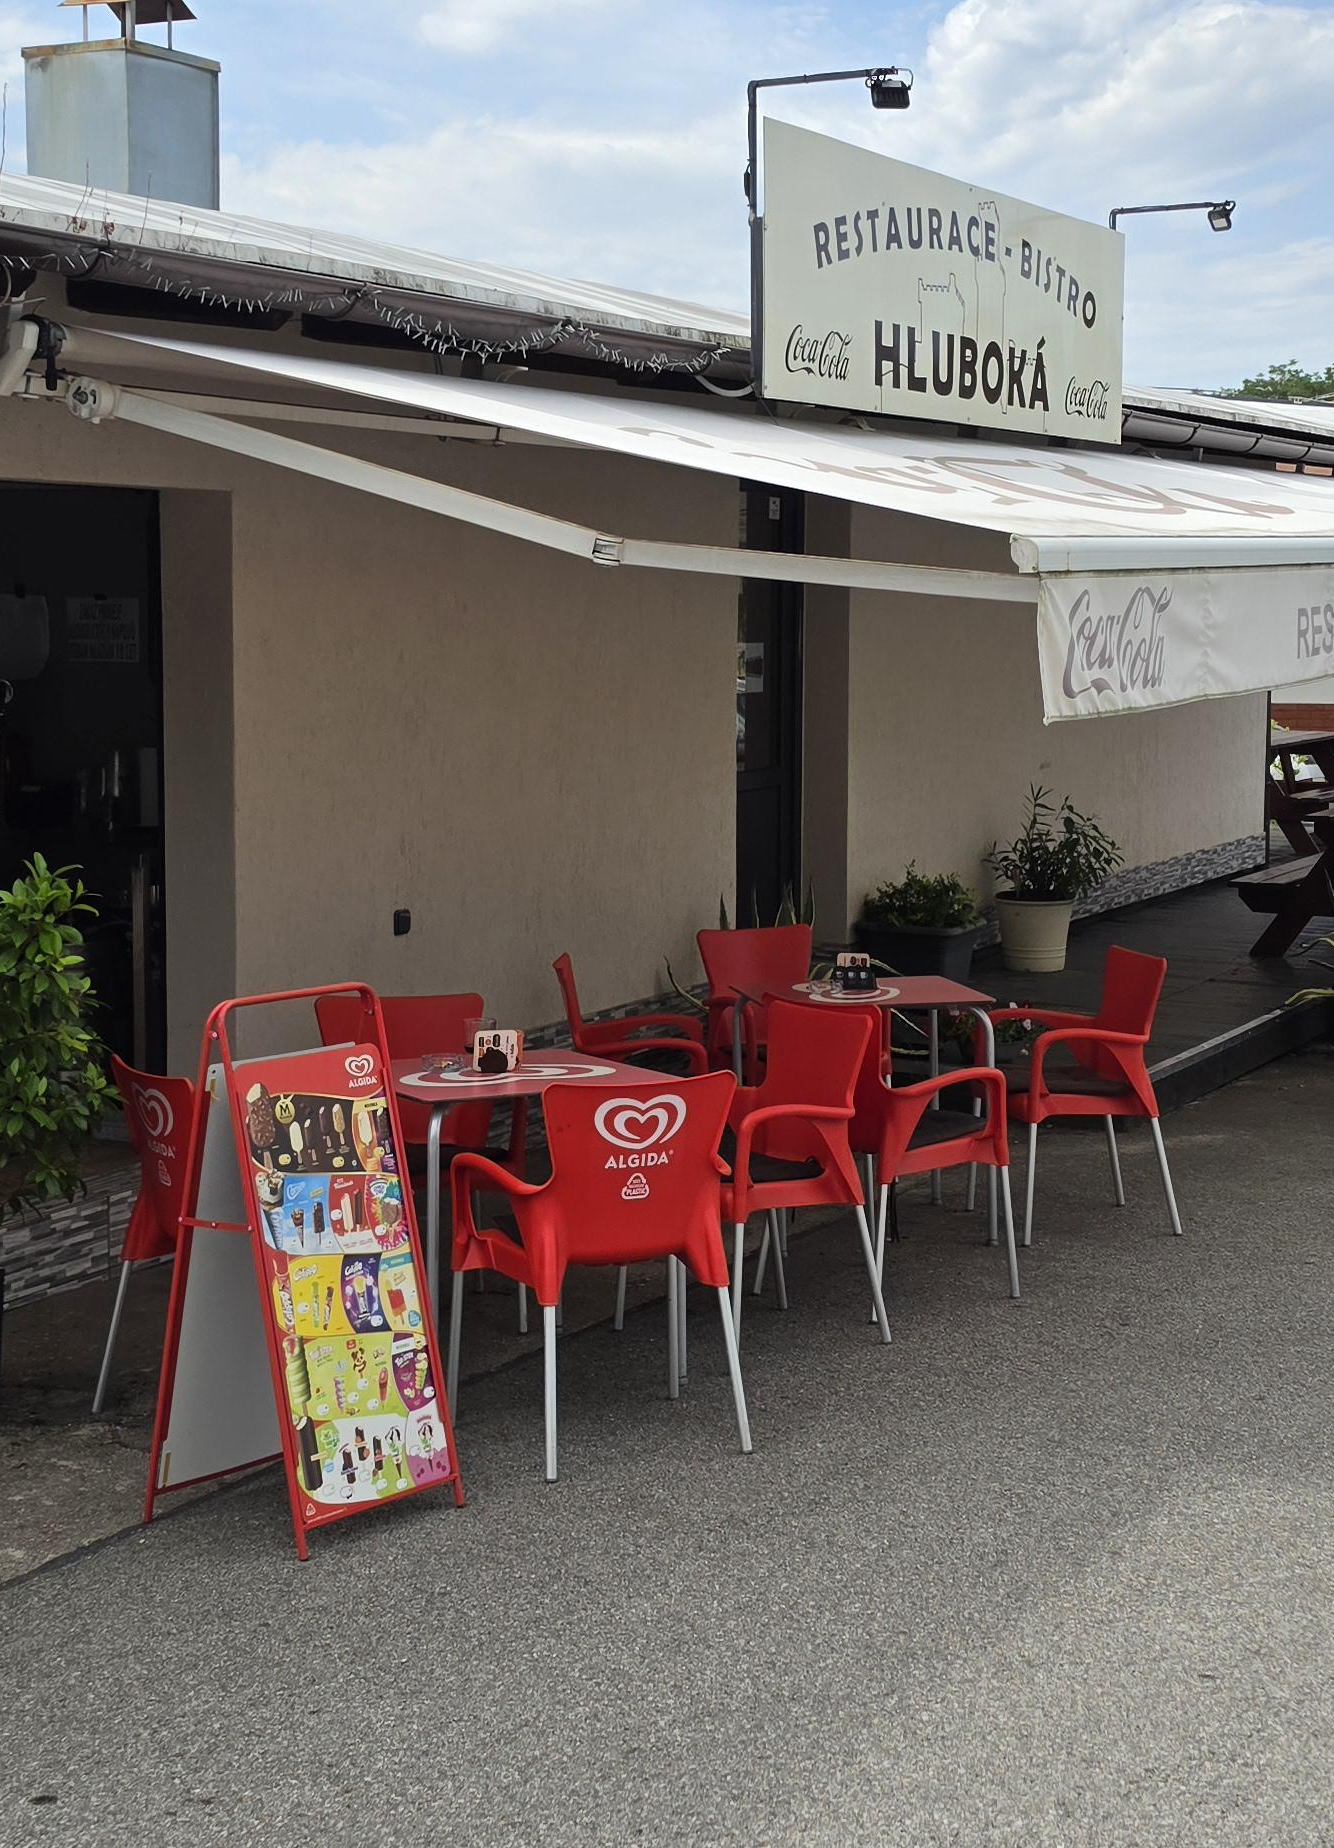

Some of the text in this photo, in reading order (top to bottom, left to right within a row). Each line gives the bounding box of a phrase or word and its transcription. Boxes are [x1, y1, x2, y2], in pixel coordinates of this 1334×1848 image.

[813, 206, 997, 269] RESTAURACE
[1020, 237, 1097, 330] BISTRO
[784, 323, 853, 382] Coca-Cola
[874, 320, 1050, 412] HLUBOKÁ
[1064, 374, 1111, 420] Coca-Cola
[1062, 584, 1174, 699] Coca-Cola
[348, 1076, 378, 1088] ALGIDA
[604, 1151, 669, 1169] ALGIDA
